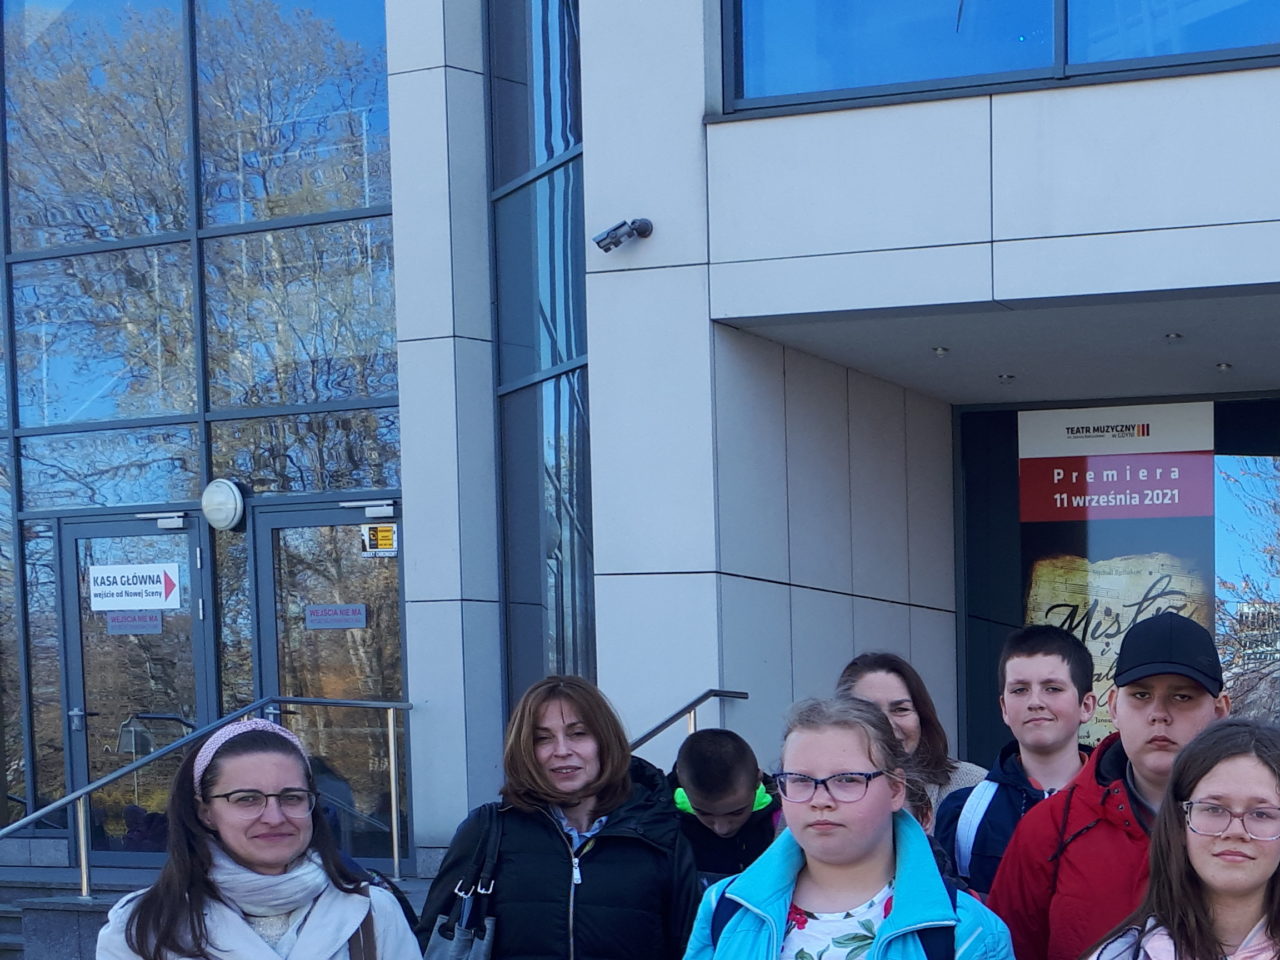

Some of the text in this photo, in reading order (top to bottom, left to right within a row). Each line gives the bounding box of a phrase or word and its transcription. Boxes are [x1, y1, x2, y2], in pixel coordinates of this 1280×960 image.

[1065, 424, 1136, 435] TEATR MUZYCZNY
[1053, 465, 1180, 484] Premiera
[1053, 489, 1180, 508] 11 września 2021
[93, 572, 162, 587] KASA GŁÓWNA
[93, 589, 163, 599] wejście od Nowej Sceny
